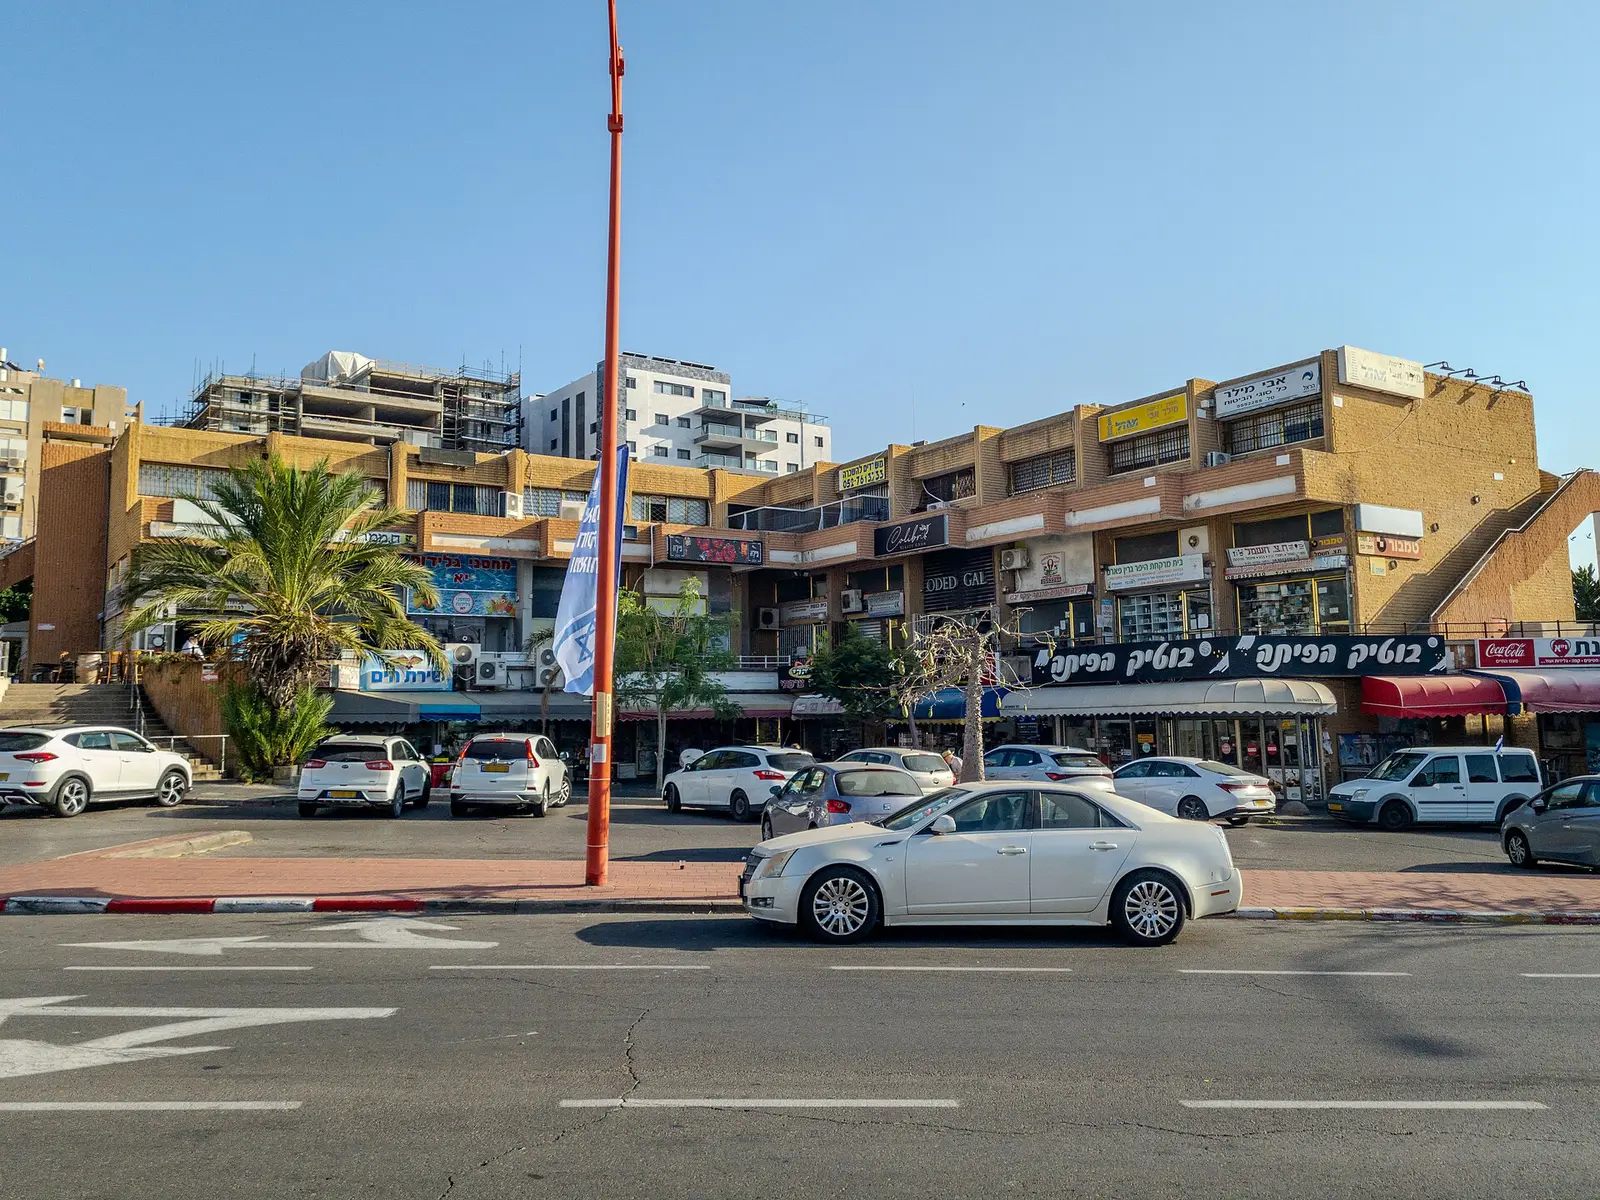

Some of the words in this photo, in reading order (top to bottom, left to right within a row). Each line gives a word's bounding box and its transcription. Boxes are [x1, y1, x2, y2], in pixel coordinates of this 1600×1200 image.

[1262, 377, 1286, 388] אבי
[1224, 385, 1255, 398] מילר
[1224, 394, 1253, 406] הביטוח
[1319, 537, 1343, 546] טמבור
[1388, 540, 1420, 555] טמבור
[1244, 546, 1271, 556] חשמל
[411, 554, 462, 568] גלידות
[468, 558, 512, 570] מחסני
[1149, 560, 1172, 571] מרקחת
[1173, 559, 1184, 567] בית
[1134, 564, 1149, 573] היפר
[926, 576, 957, 592] ODED
[963, 571, 988, 587] GAL
[1347, 638, 1422, 670] בוטיק
[1485, 642, 1527, 658] Coca-Cola
[1126, 642, 1195, 677] בוטיק
[1255, 643, 1337, 673] הפיתה
[1051, 652, 1116, 683] הפיתה
